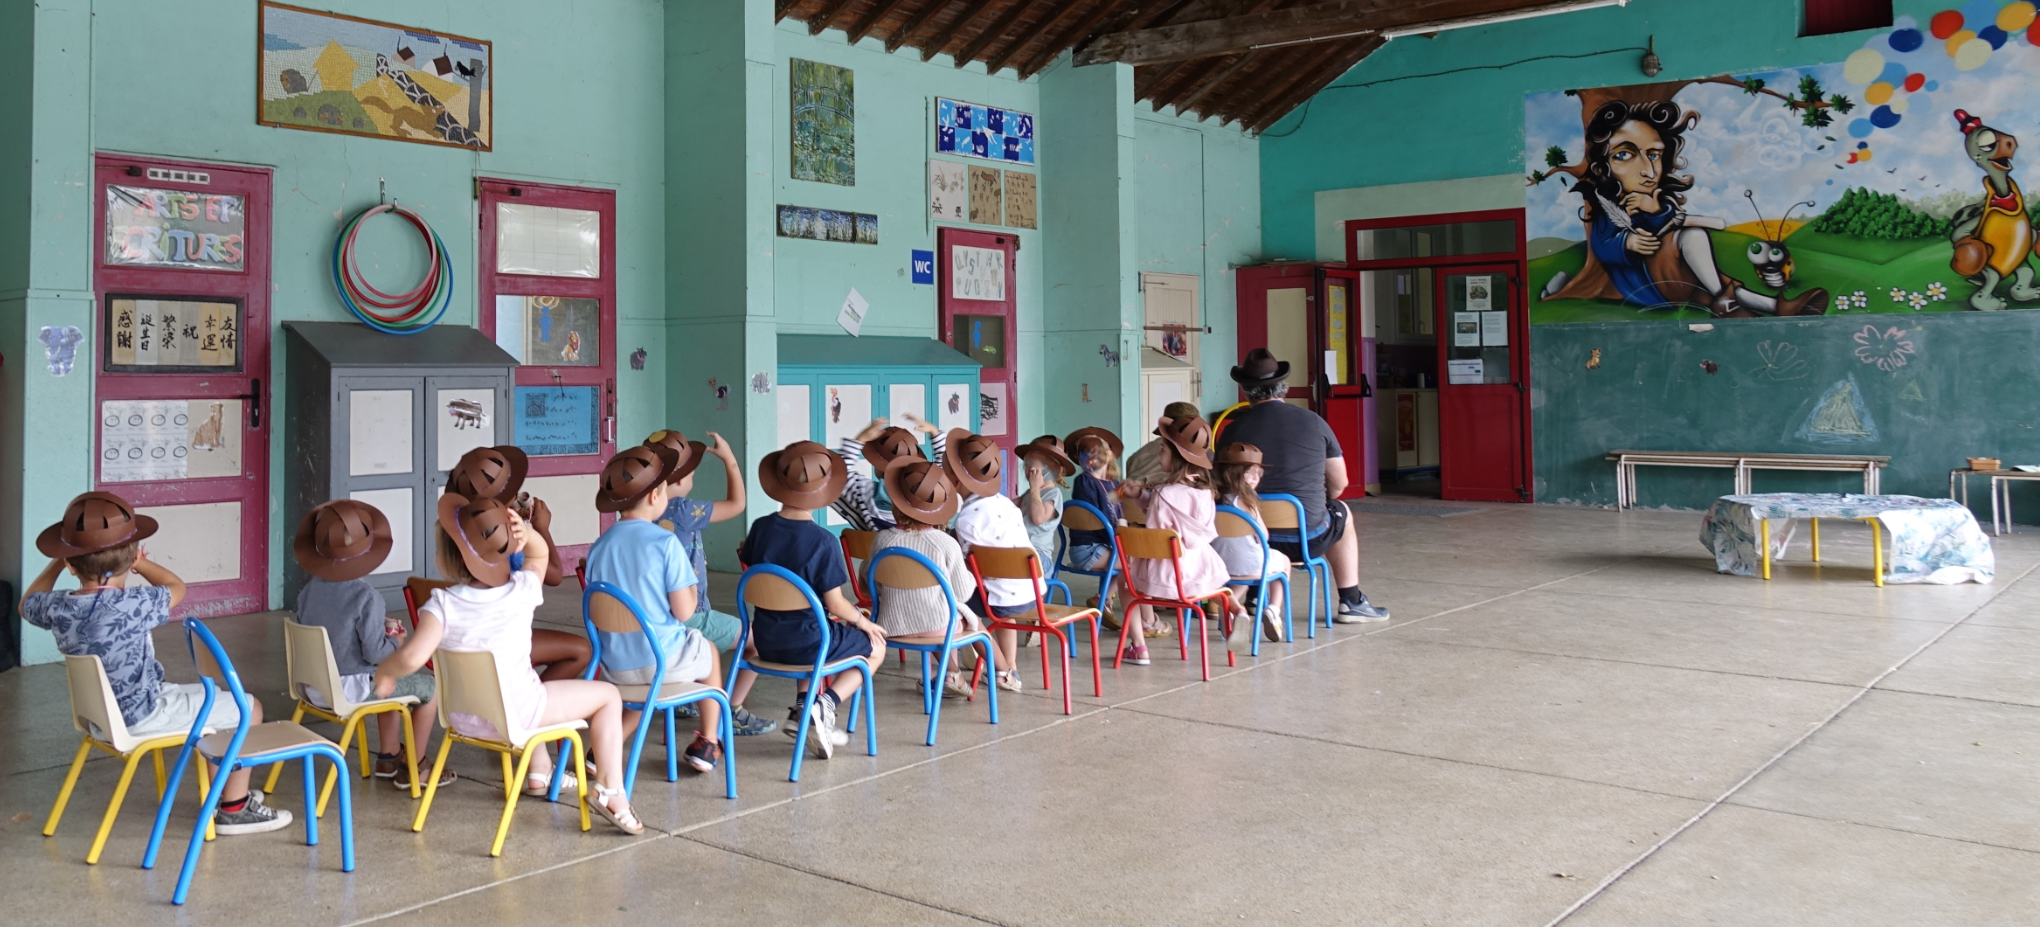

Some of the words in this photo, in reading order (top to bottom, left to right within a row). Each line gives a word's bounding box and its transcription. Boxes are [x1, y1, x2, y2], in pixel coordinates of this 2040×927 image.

[133, 191, 200, 221] ARTS
[914, 260, 931, 274] WC
[182, 323, 199, 340] 祝
[201, 314, 218, 351] 幸運
[219, 316, 237, 349] 友情
